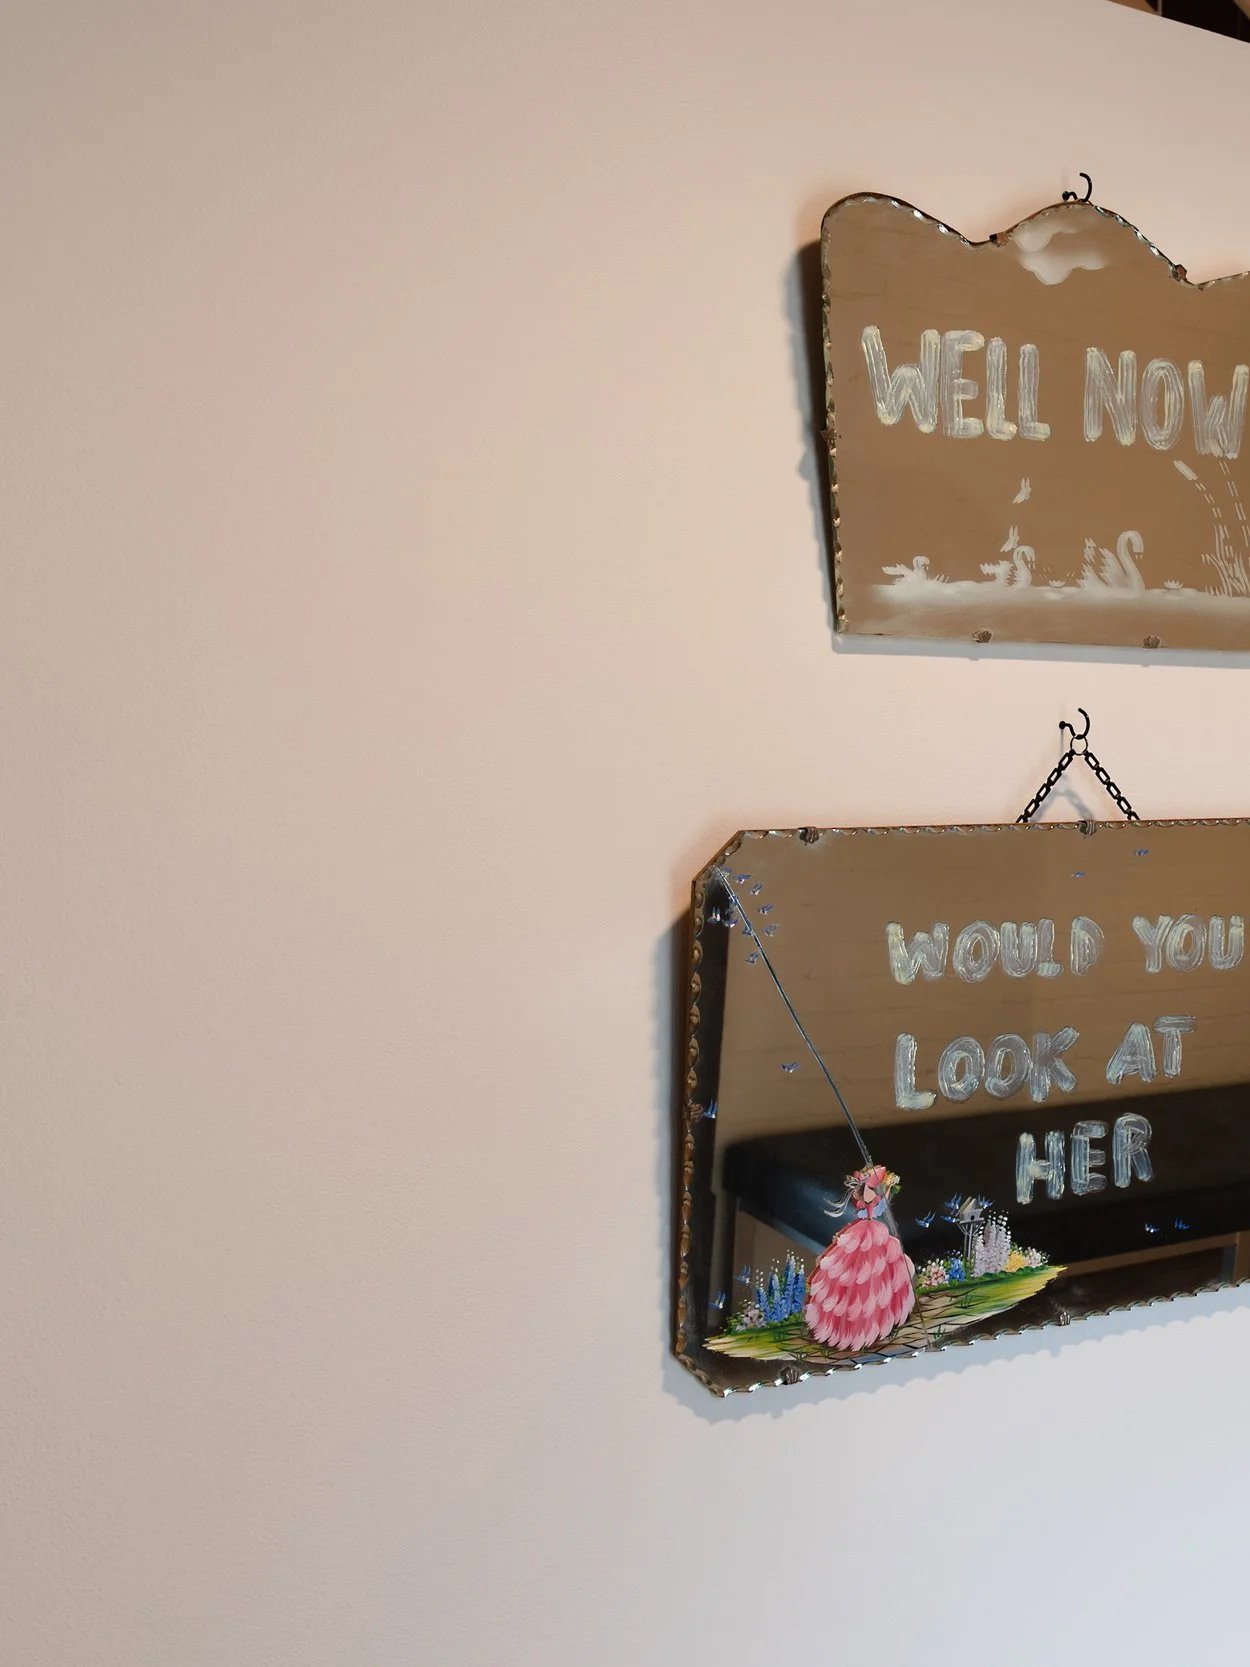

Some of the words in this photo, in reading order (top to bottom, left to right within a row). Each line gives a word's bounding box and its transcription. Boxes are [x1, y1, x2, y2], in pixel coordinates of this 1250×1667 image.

[861, 324, 1051, 442] WELL
[1083, 346, 1250, 460] NOW
[884, 914, 1105, 986] WOULD
[893, 1026, 1080, 1112] LOOK
[1105, 1014, 1197, 1086] AT
[1015, 1112, 1156, 1205] HER
